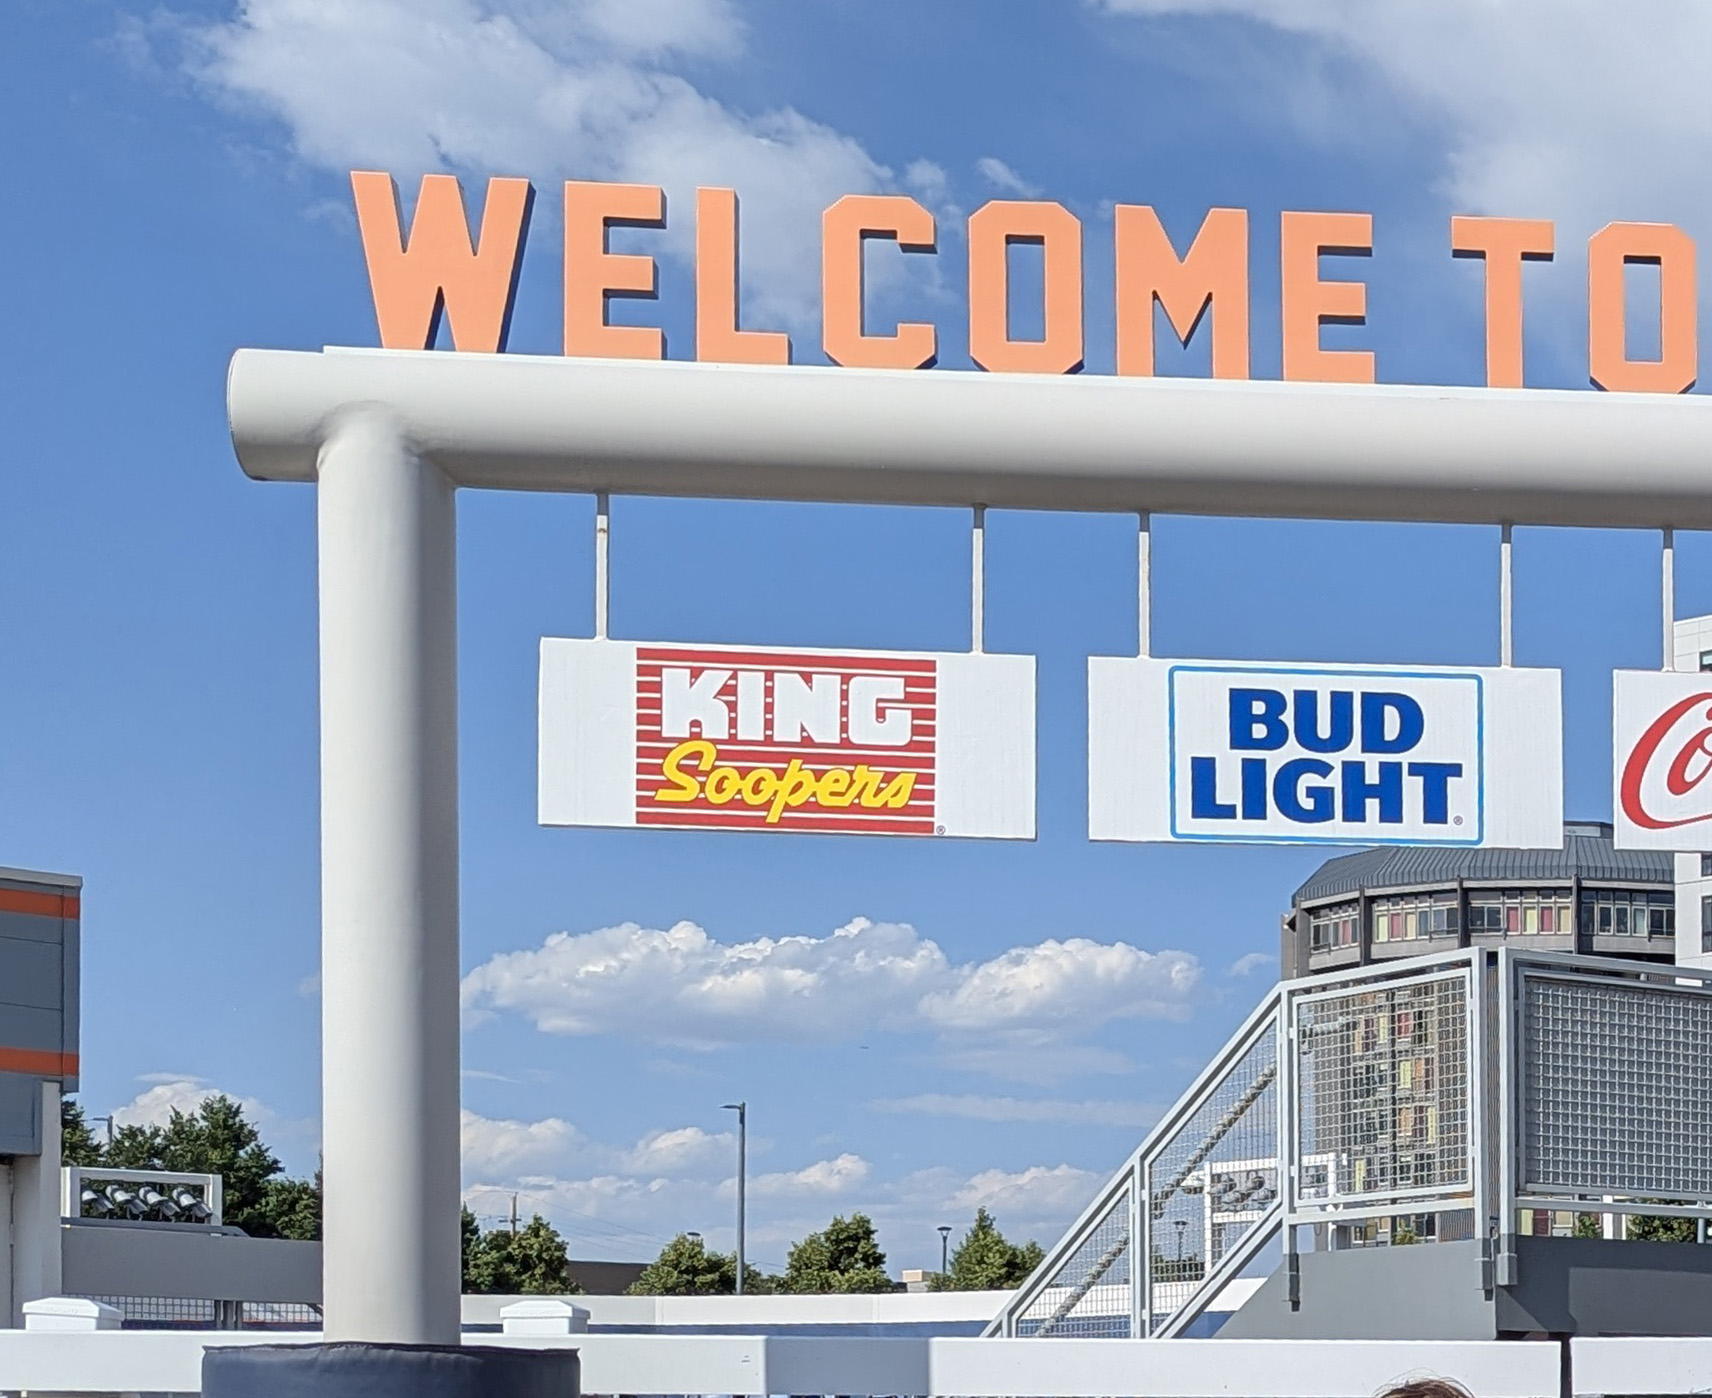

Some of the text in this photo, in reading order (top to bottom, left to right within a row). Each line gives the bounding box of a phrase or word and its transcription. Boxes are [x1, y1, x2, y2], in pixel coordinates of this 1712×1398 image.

[351, 170, 1376, 384] WELCOME
[1451, 215, 1697, 394] TO
[661, 667, 912, 746] KING
[1228, 688, 1424, 754] BUD
[655, 740, 917, 823] Soopers
[1191, 756, 1462, 824] LIGHT
